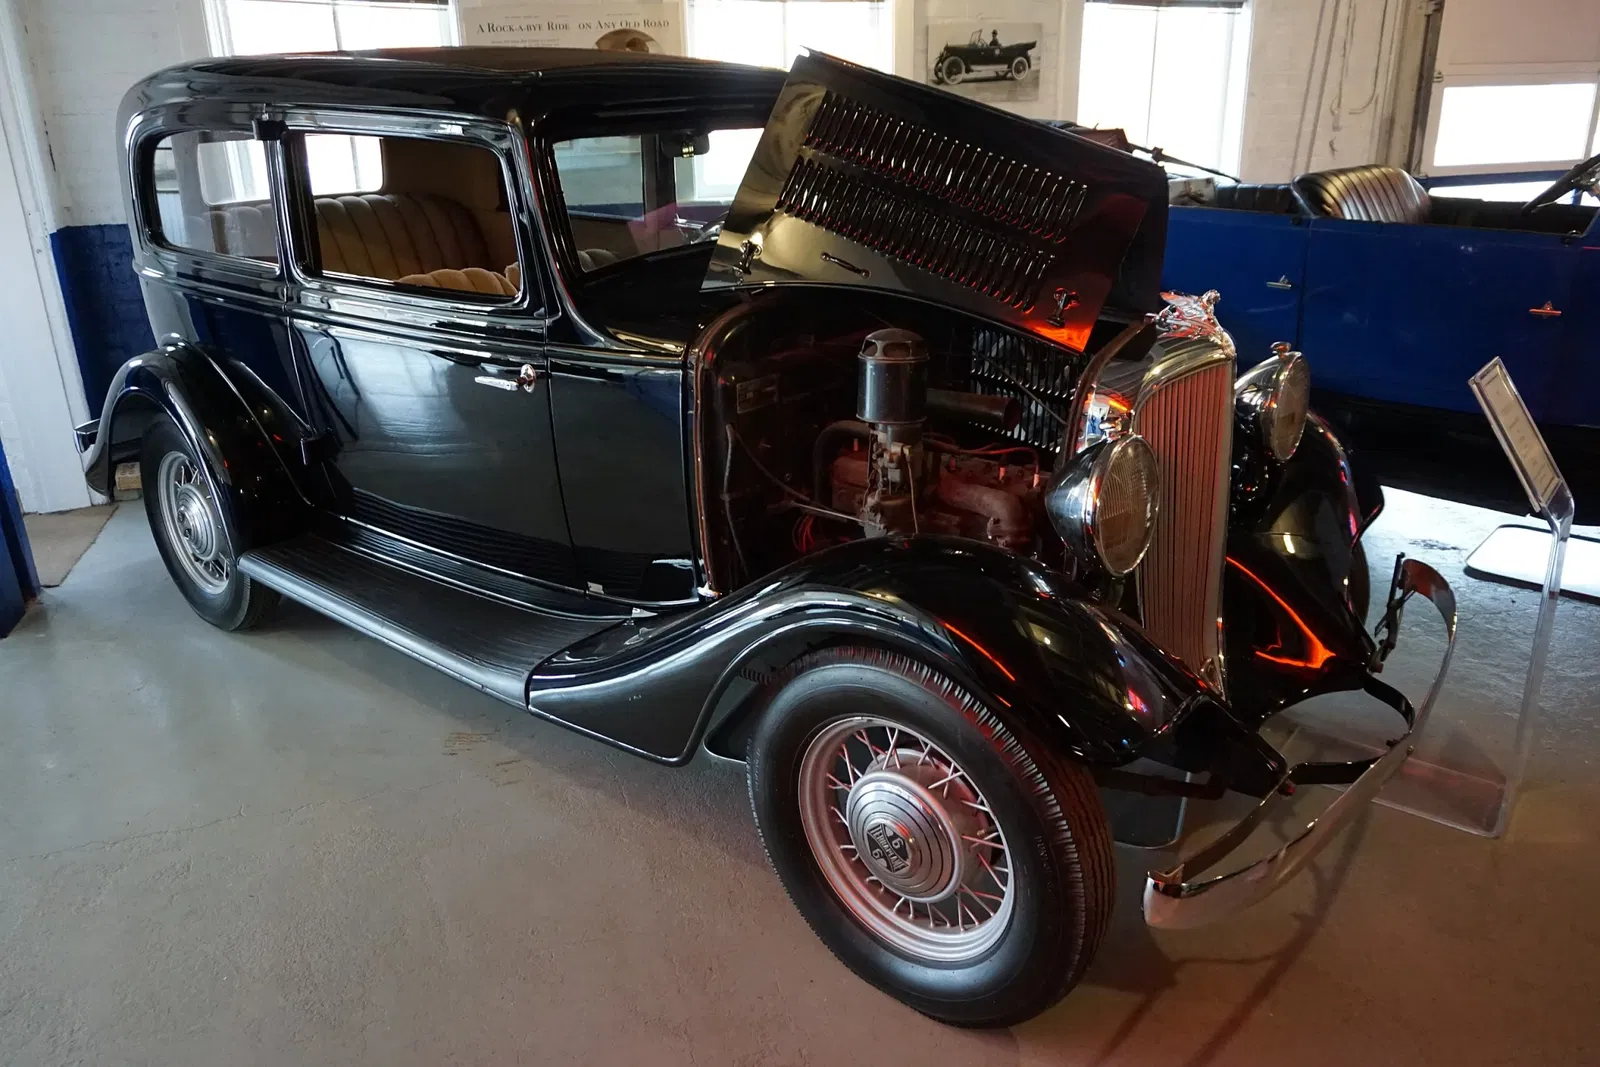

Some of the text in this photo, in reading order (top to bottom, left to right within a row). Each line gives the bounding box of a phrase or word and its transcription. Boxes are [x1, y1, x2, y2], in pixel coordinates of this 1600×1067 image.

[477, 18, 670, 34] A ROCK-A-BYE RIDE ON ANY OLD ROAD
[869, 824, 908, 871] TERRAPLANE
[892, 837, 904, 849] 6
[872, 848, 884, 859] 6
